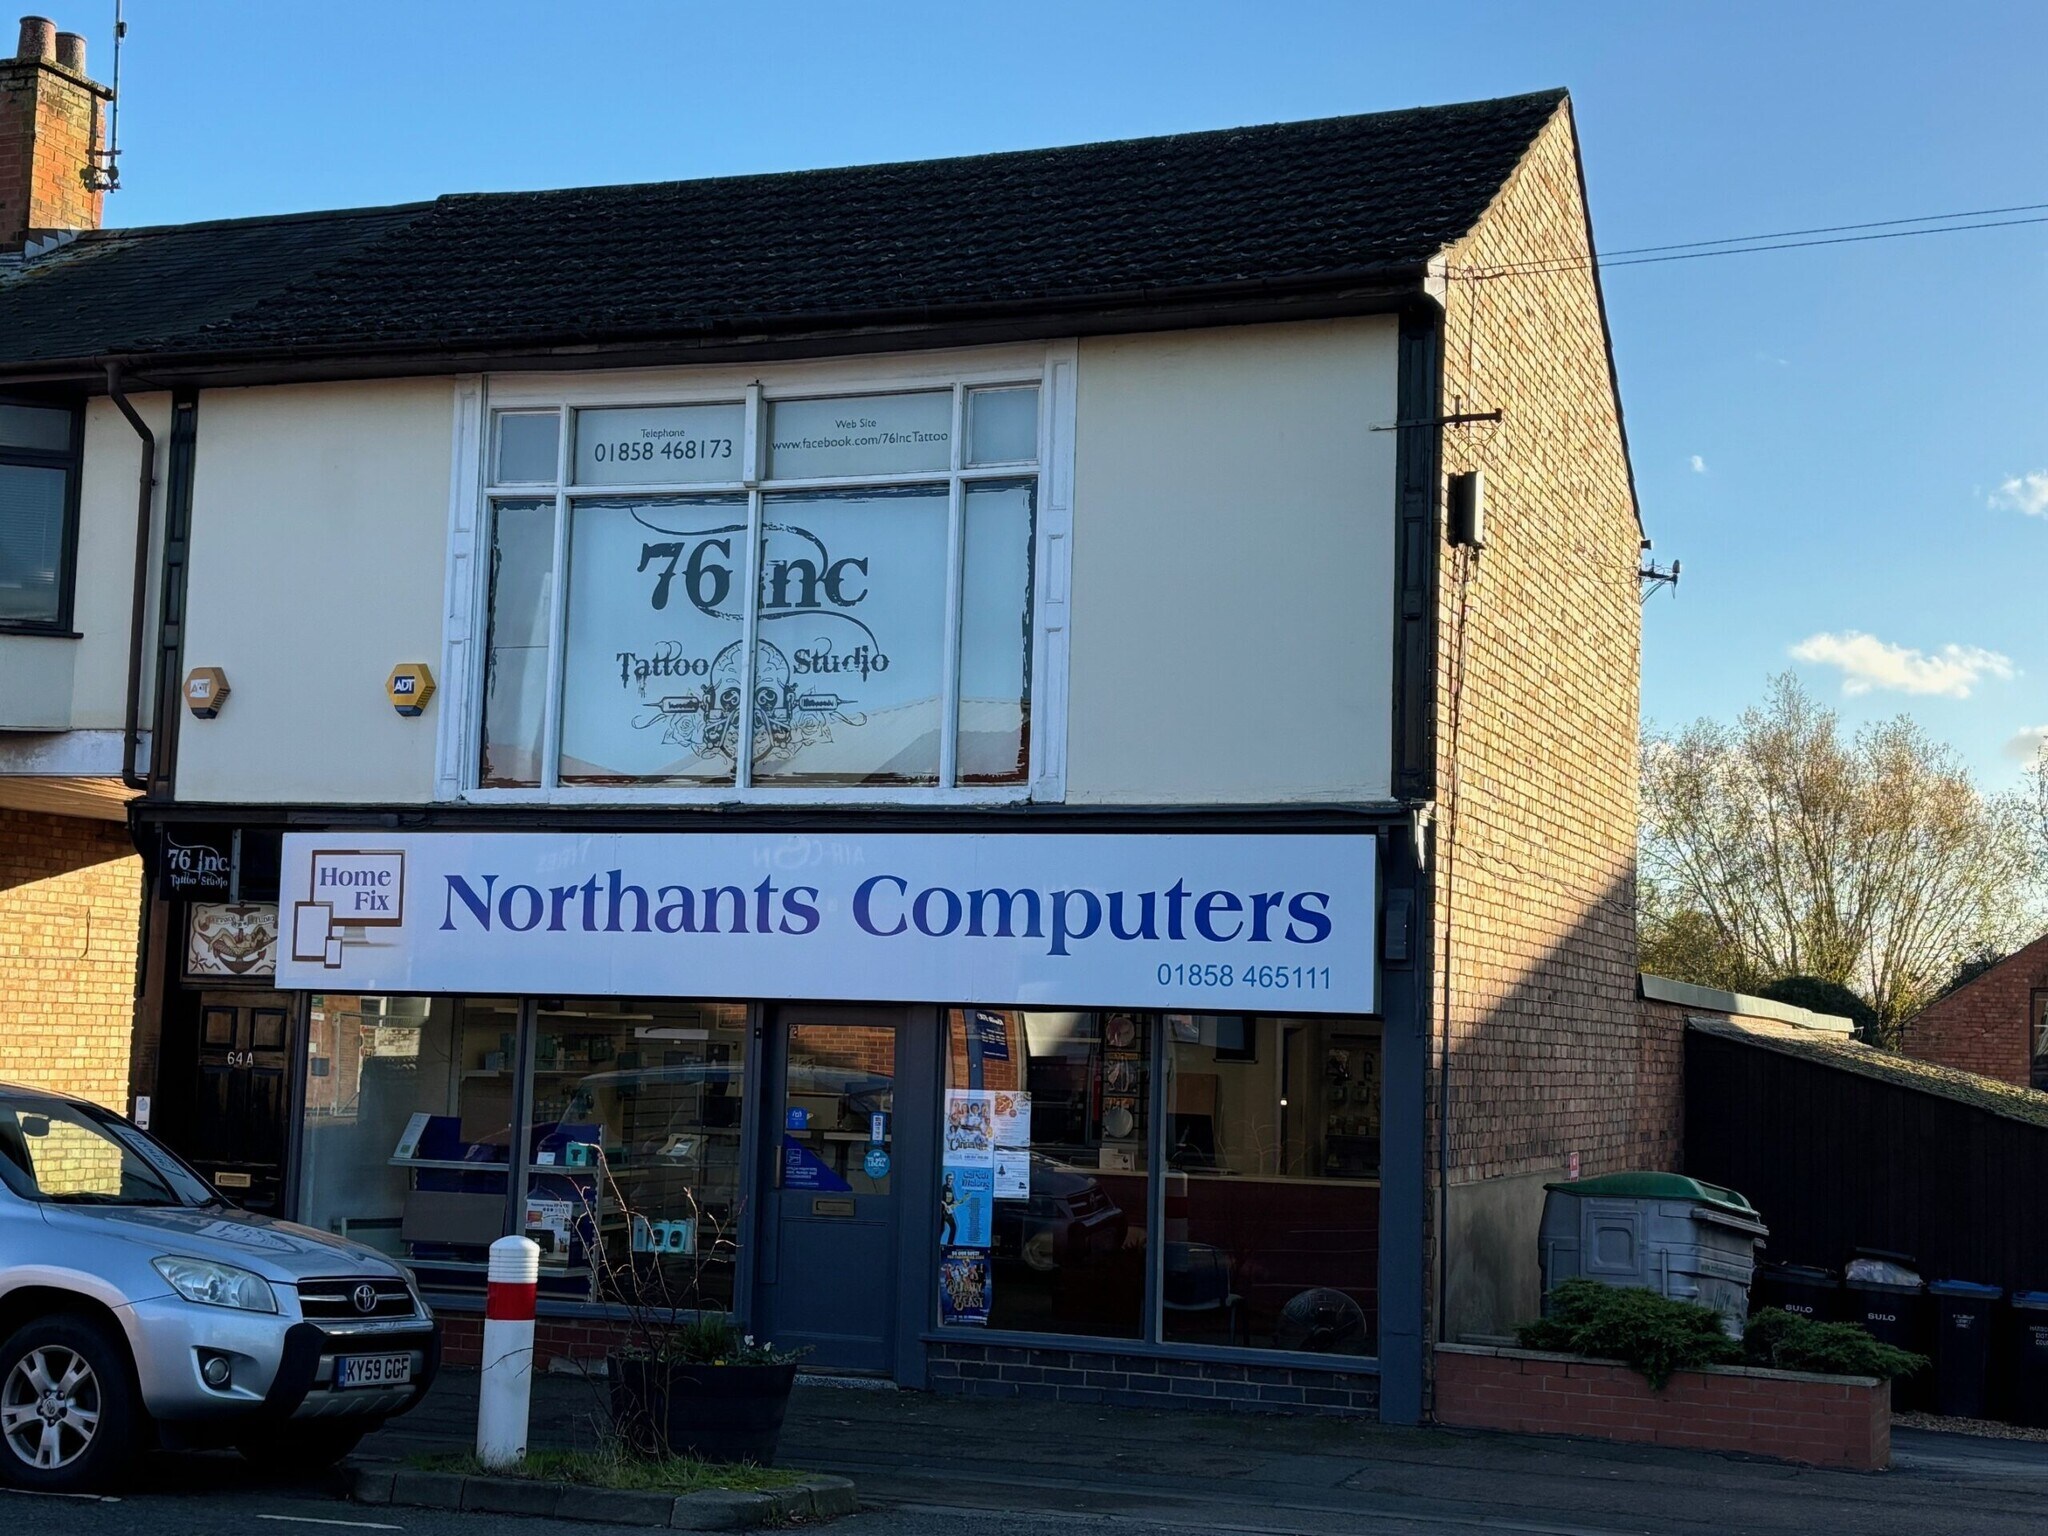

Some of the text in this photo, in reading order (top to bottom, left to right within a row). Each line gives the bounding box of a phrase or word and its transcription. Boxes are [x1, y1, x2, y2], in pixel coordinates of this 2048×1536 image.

[640, 427, 686, 439] Telephone
[835, 418, 877, 429] Web Site
[594, 439, 733, 464] 01858 468173
[636, 538, 733, 611] 76
[616, 641, 890, 688] Tattoo Studio
[394, 677, 415, 693] ADT
[167, 849, 191, 870] 76
[201, 875, 228, 888] Studio
[320, 867, 392, 887] Home
[354, 889, 390, 911] Fix
[439, 869, 1332, 956] Northants Computers
[1157, 963, 1331, 990] 01858 465111
[1785, 1303, 1814, 1314] SULO
[1867, 1312, 1896, 1322] SULO
[346, 1357, 409, 1382] KY59 GGF
